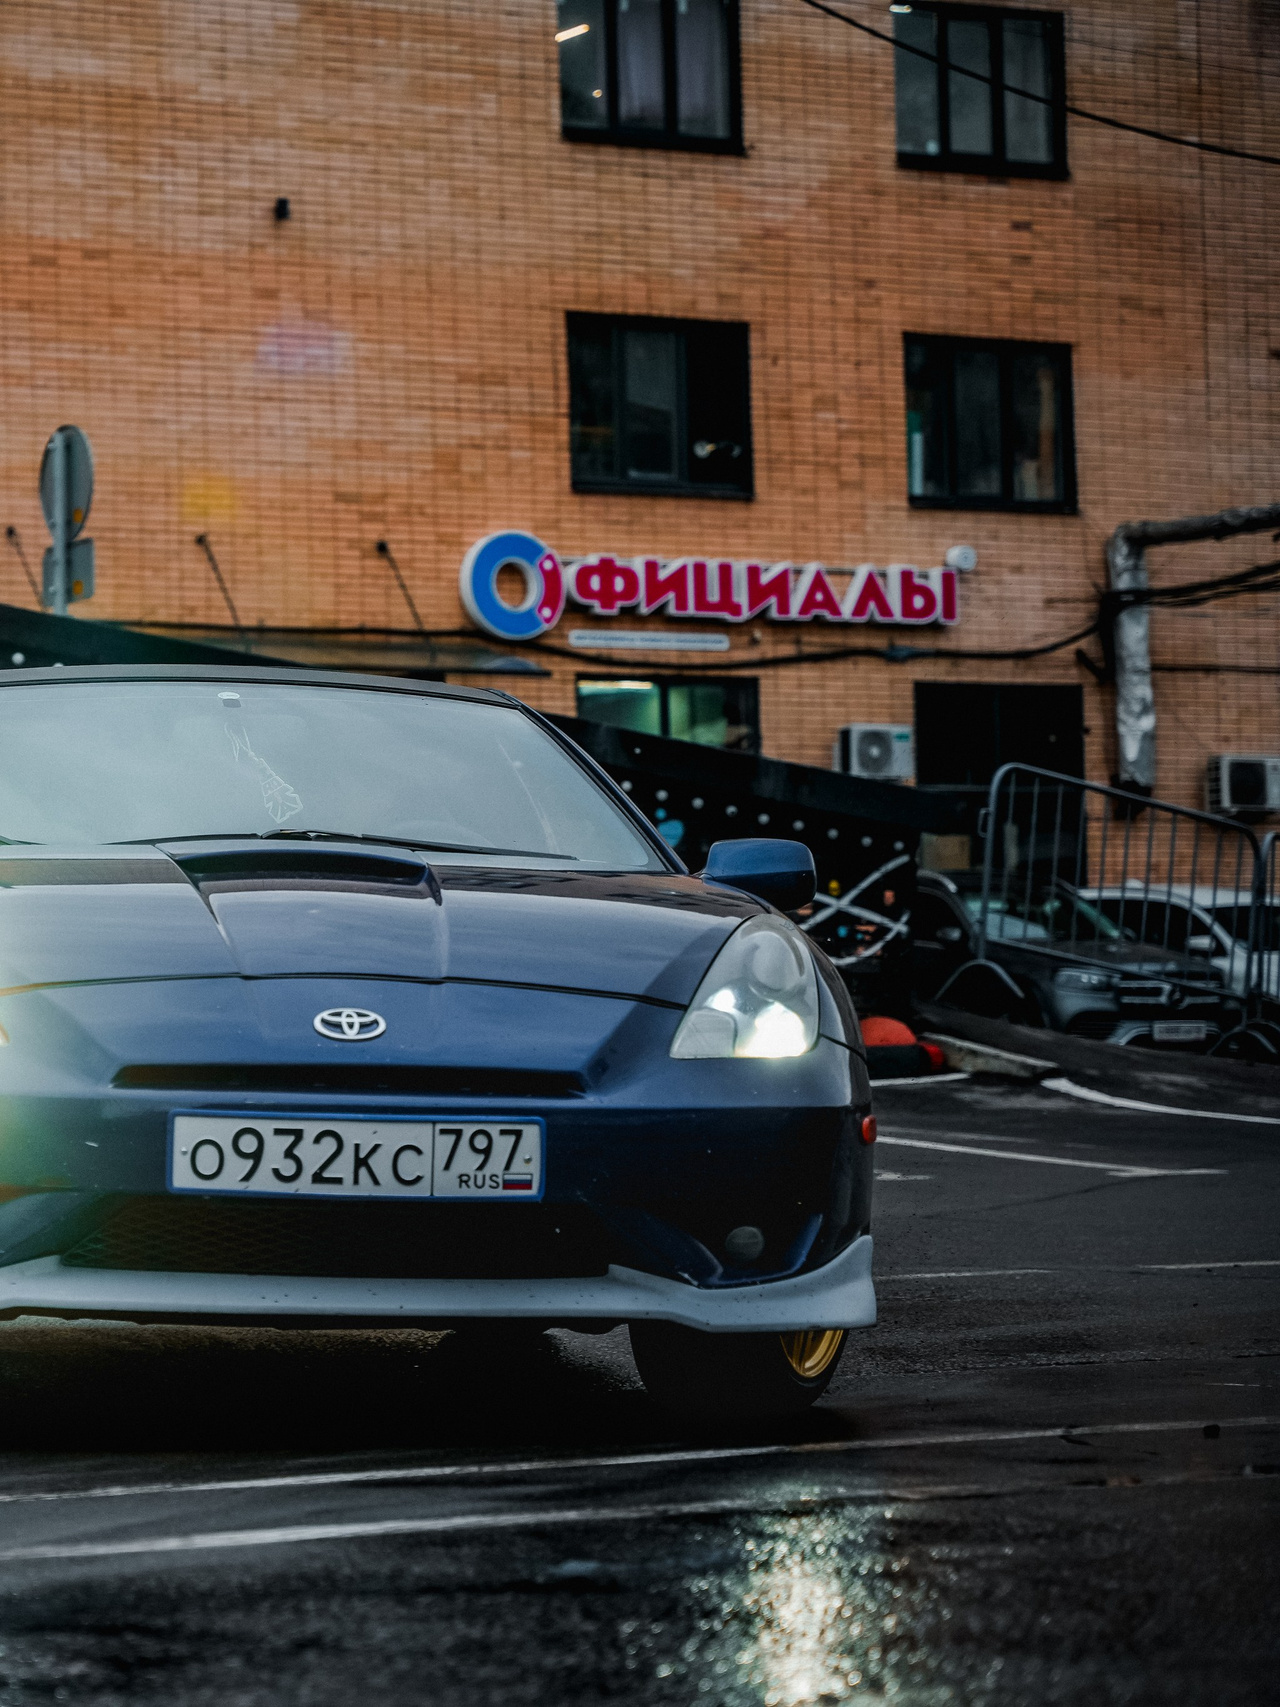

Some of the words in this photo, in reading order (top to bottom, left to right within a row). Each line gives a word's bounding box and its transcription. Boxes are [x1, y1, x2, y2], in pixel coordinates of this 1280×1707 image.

[461, 531, 959, 639] ОФИЦИАЛЫ
[438, 1128, 524, 1172] 797
[458, 1173, 501, 1190] RUS
